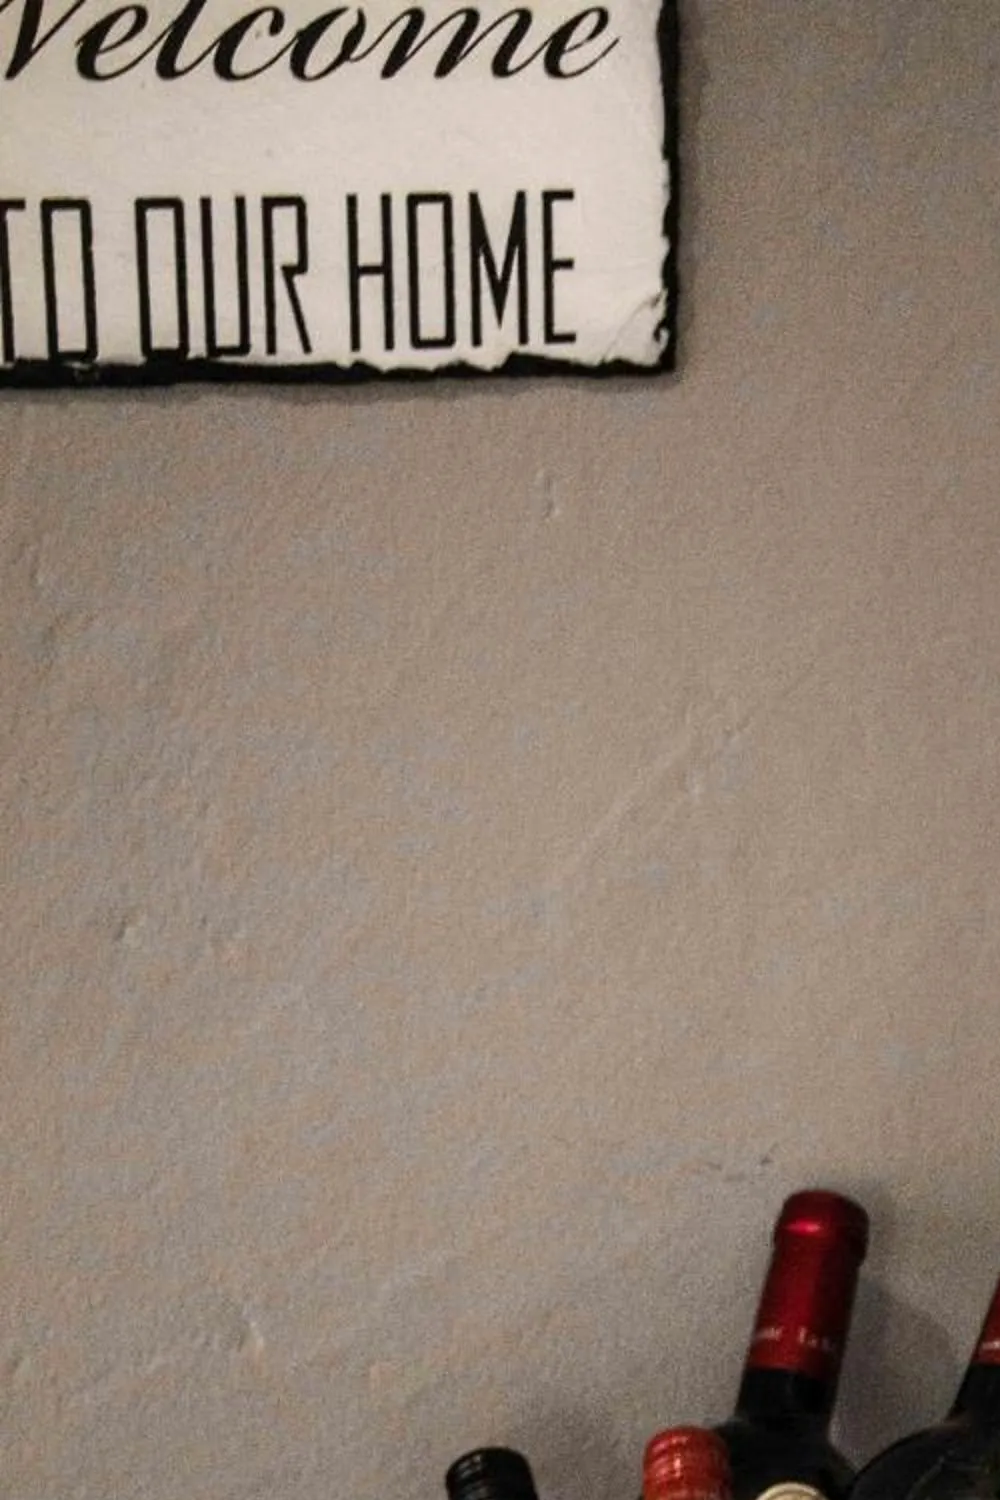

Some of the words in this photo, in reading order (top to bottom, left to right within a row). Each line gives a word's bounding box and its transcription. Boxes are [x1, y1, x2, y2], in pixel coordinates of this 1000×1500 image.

[0, 196, 98, 362] TO
[135, 194, 311, 360] OUR
[346, 190, 577, 352] HOME
